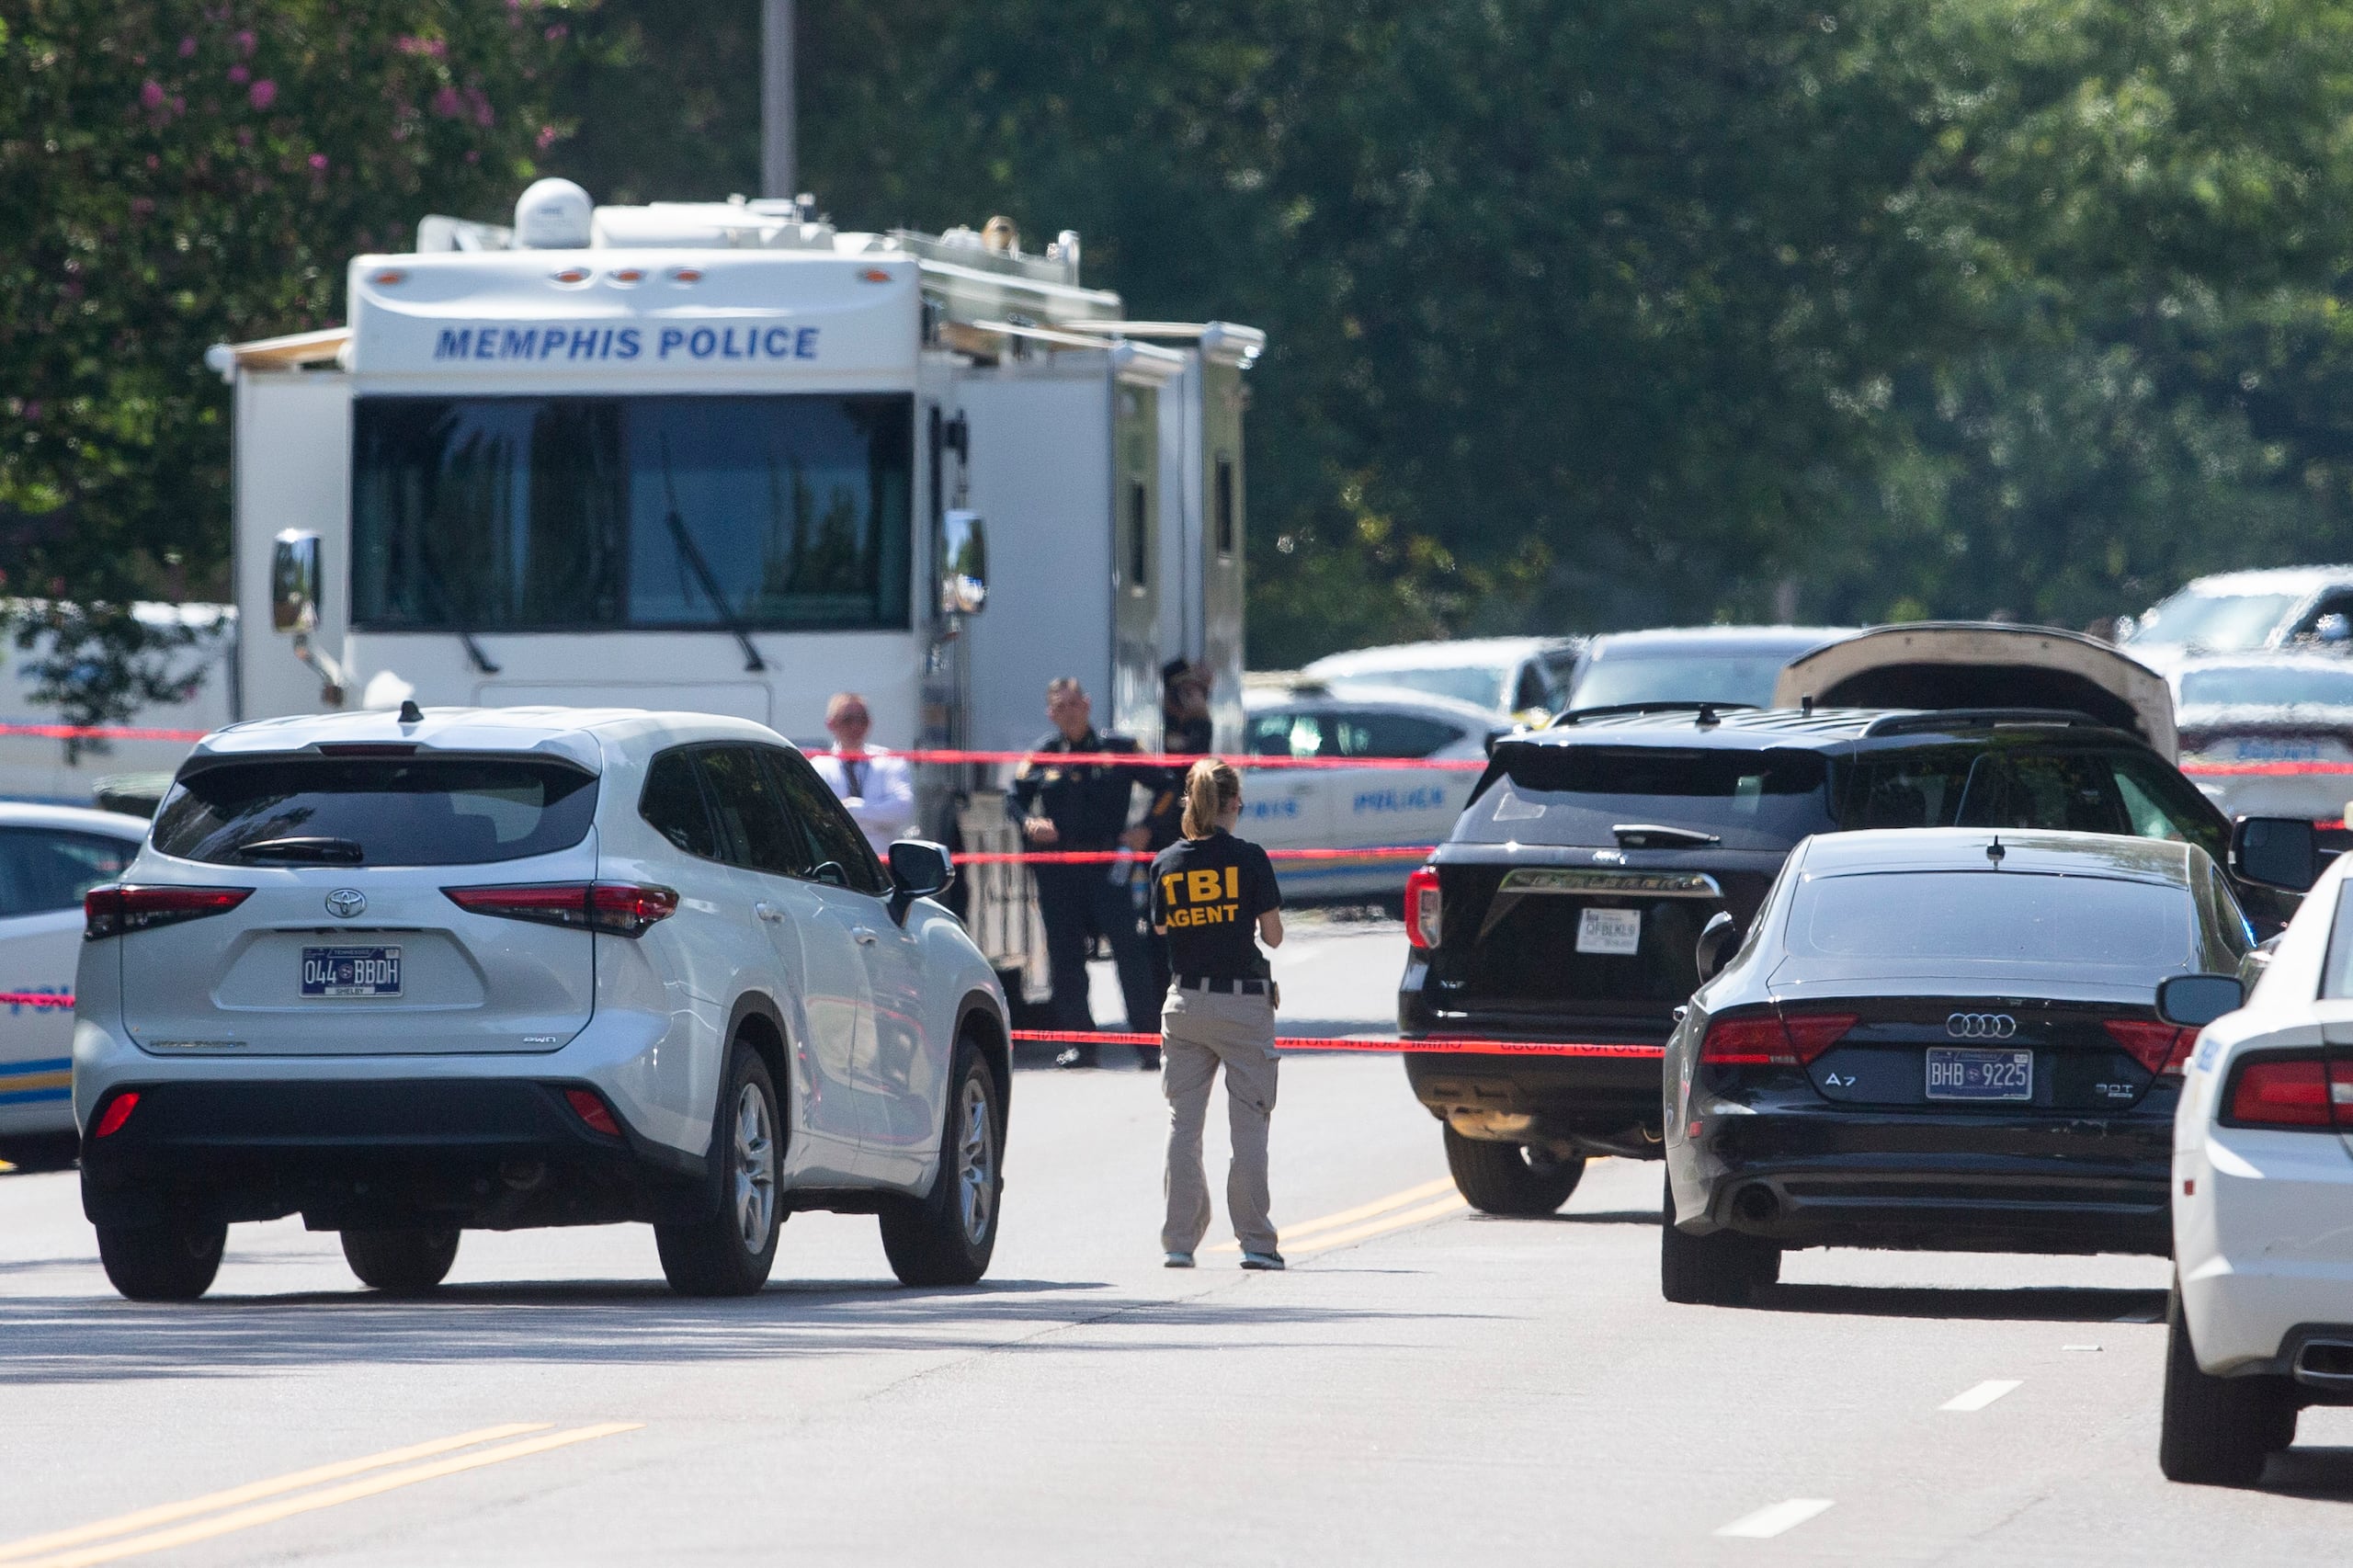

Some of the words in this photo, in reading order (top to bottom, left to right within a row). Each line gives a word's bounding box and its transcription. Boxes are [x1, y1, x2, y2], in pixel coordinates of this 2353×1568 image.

[434, 326, 642, 361] MEMPHIS
[657, 326, 819, 359] POLICE
[1161, 866, 1239, 905] TBI
[1165, 903, 1239, 928] AGENT
[304, 960, 337, 984] 044
[354, 960, 398, 984] BBDH
[1825, 1072, 1857, 1086] A7
[1931, 1062, 1964, 1085] BHB
[1983, 1062, 2026, 1086] 9225
